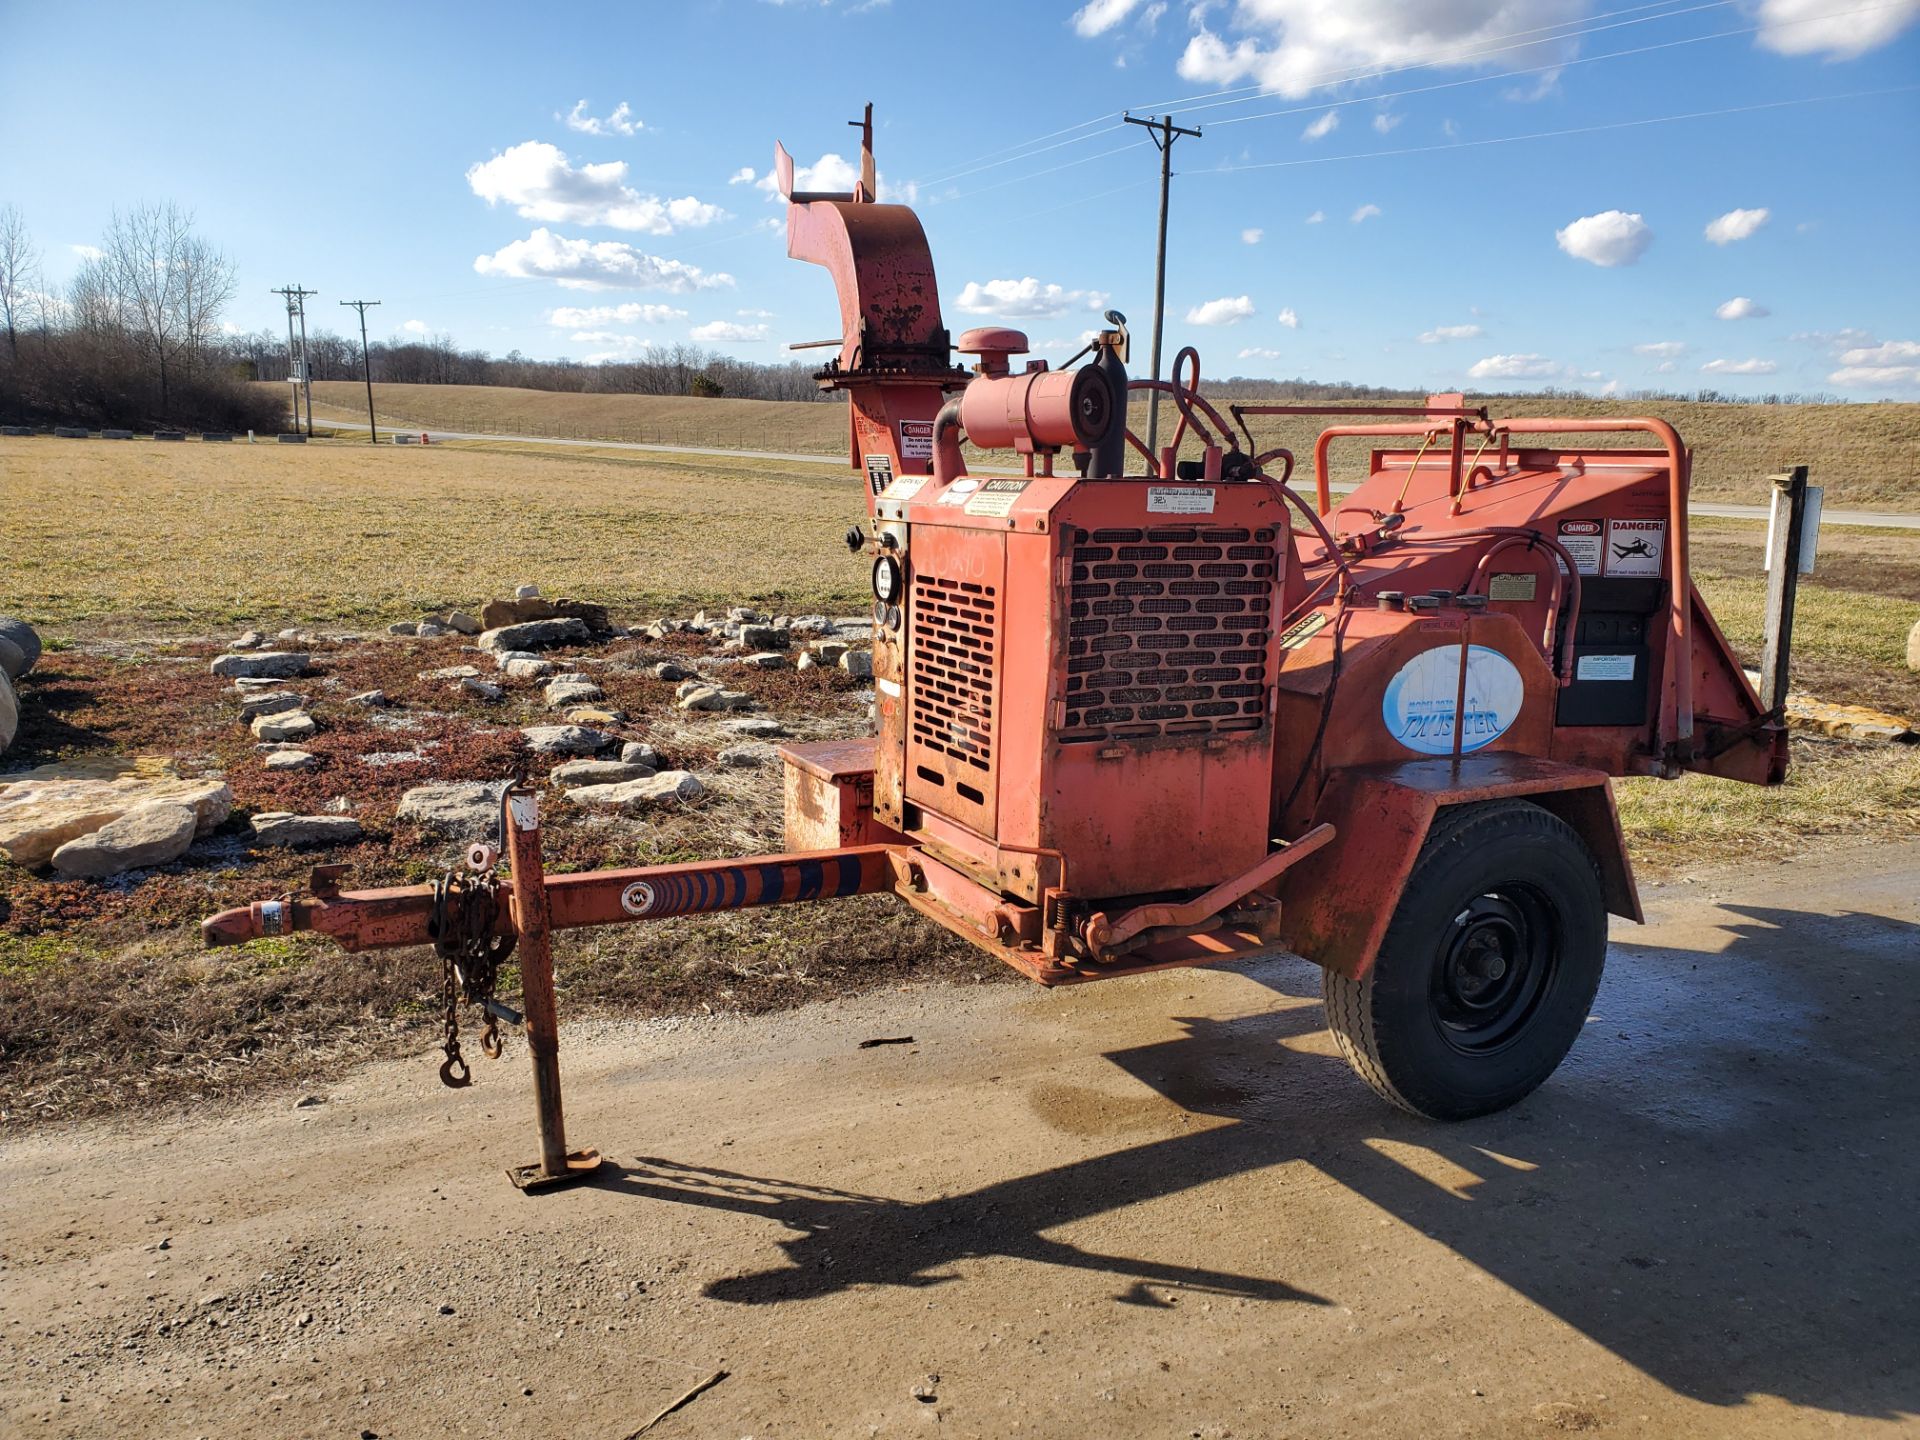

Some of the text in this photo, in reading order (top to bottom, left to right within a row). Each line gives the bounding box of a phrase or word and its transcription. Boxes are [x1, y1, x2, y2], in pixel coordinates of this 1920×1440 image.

[986, 480, 1028, 491] CAUTION
[1567, 524, 1594, 533] DANGER
[1612, 522, 1663, 531] DANGER!
[1397, 708, 1503, 739] TWISTER
